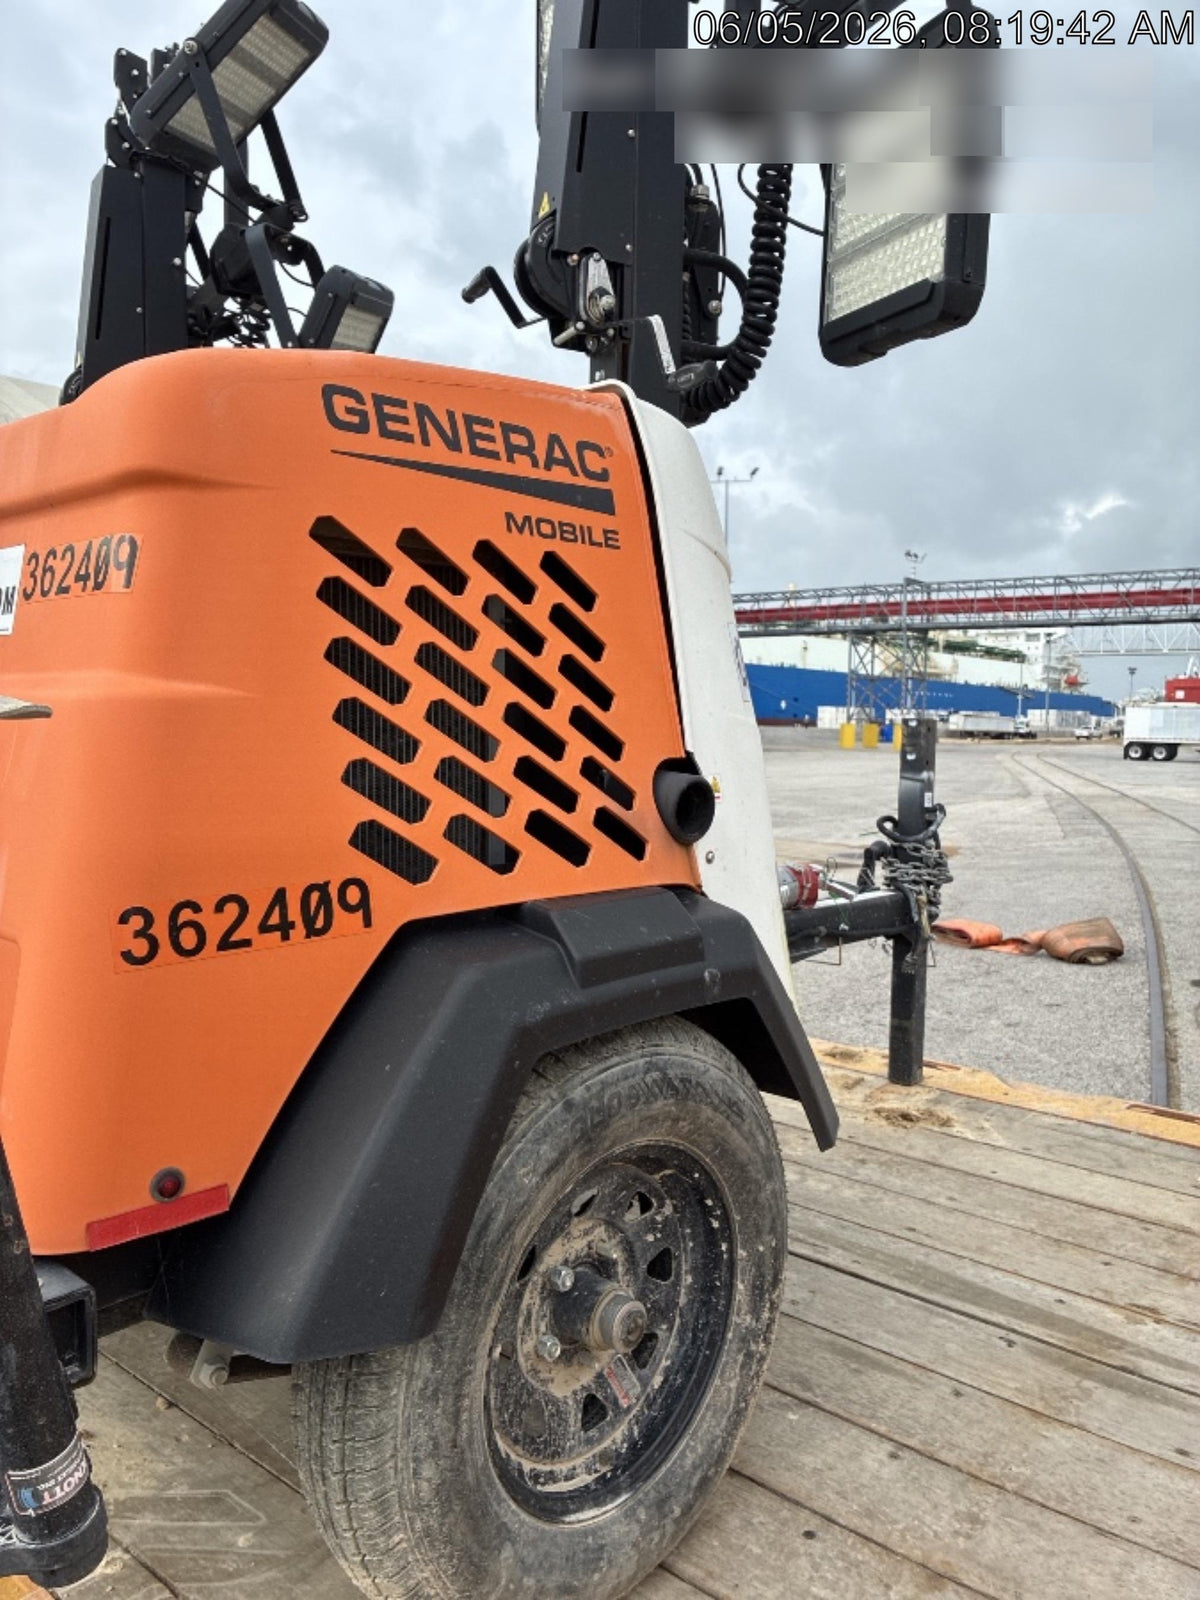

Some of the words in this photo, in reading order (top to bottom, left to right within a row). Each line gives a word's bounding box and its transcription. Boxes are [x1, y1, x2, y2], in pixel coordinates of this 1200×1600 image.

[321, 384, 610, 482] GENERAC
[22, 534, 139, 602] 362409
[504, 511, 621, 550] MOBILE
[117, 877, 373, 966] 362409
